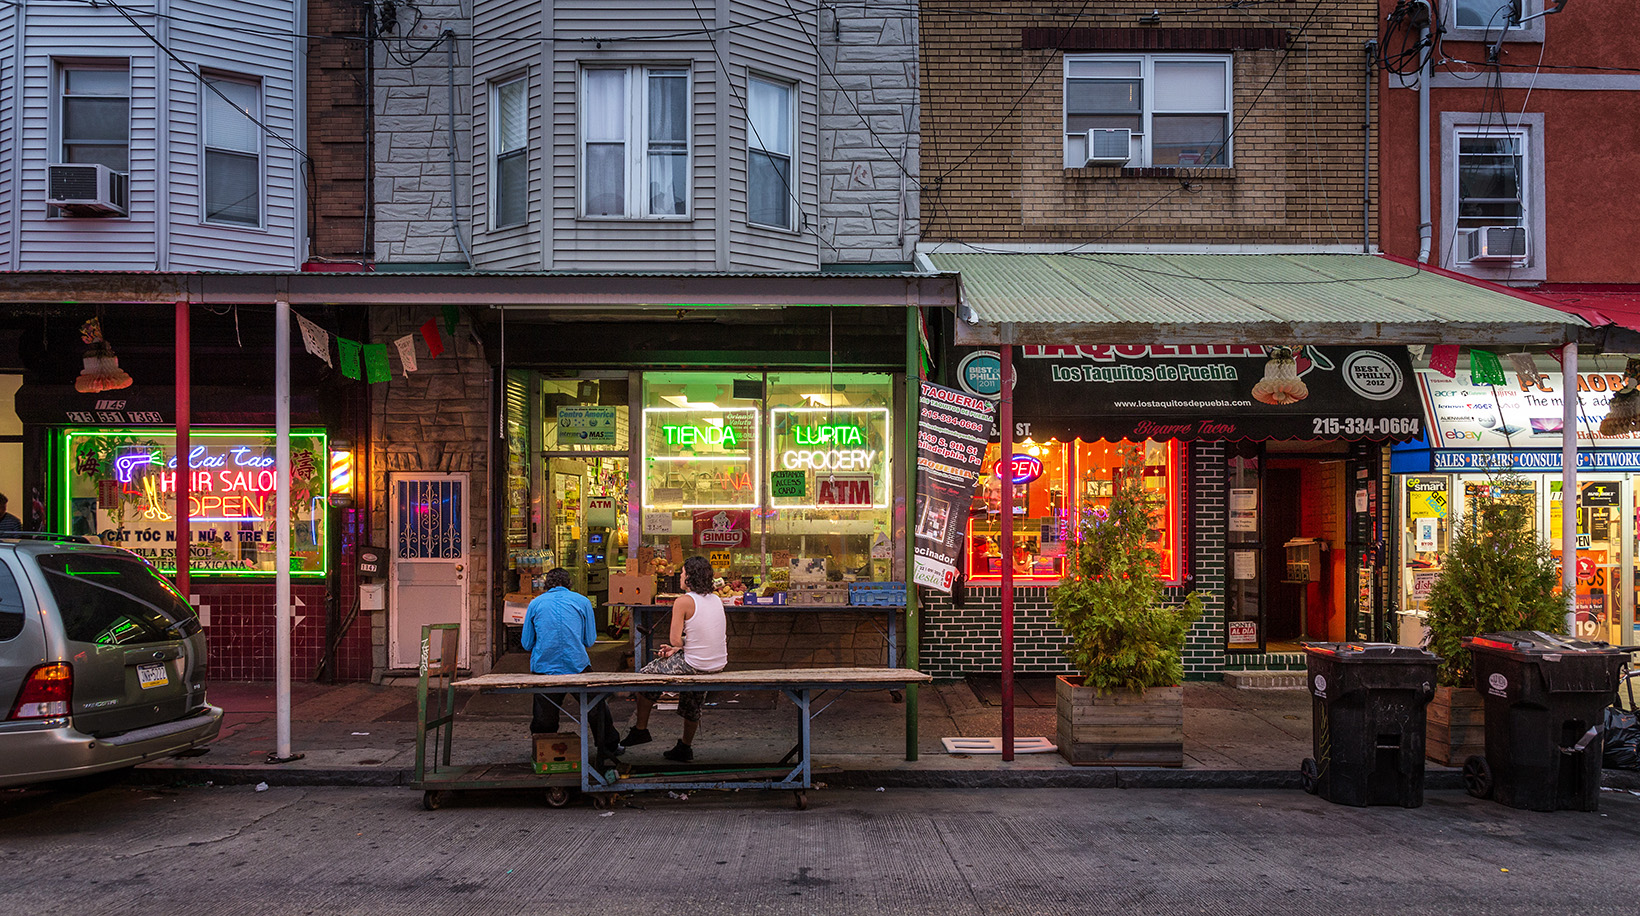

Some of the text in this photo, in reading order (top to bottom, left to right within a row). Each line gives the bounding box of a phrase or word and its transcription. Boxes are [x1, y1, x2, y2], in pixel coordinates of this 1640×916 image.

[1052, 364, 1238, 383] Los Taquitos de Puebla
[921, 384, 985, 412] TAQUERIA
[1113, 399, 1251, 409] www.lostaquitosdepuebla.com
[1524, 395, 1549, 406] The
[69, 412, 162, 422] 215 551 7369
[930, 399, 961, 413] TAQUITOS
[960, 407, 970, 416] DE
[969, 411, 994, 422] PUEBLA
[921, 408, 984, 432] 215-334-0664
[1133, 419, 1236, 438] Bizarre Tacos
[1312, 416, 1419, 435] 215-334-0664
[662, 424, 738, 446] TIENDA
[796, 424, 863, 446] LUPITA
[1015, 422, 1033, 436] ST.
[1445, 428, 1483, 442] ebay
[918, 440, 982, 467] hiladelphia, Pa
[938, 437, 949, 447] S.
[949, 440, 966, 452] 9th
[966, 445, 979, 456] St
[783, 450, 876, 469] GROCERY
[1434, 453, 1466, 467] SALES
[1471, 453, 1514, 467] REPAIRS
[1519, 453, 1584, 467] CONSULTG
[160, 471, 213, 494] HIR
[776, 478, 802, 487] ACCESS
[778, 486, 797, 495] CARD
[1414, 482, 1445, 492] smart
[818, 480, 871, 505] ATM
[1431, 490, 1447, 506] GET
[589, 500, 612, 509] ATM
[223, 530, 233, 542] &
[703, 532, 740, 542] BIMBO
[161, 543, 213, 557] ESÑOL
[914, 546, 955, 565] ocinador
[943, 570, 954, 589] 9
[1231, 629, 1241, 637] AL
[1576, 620, 1597, 637] 19
